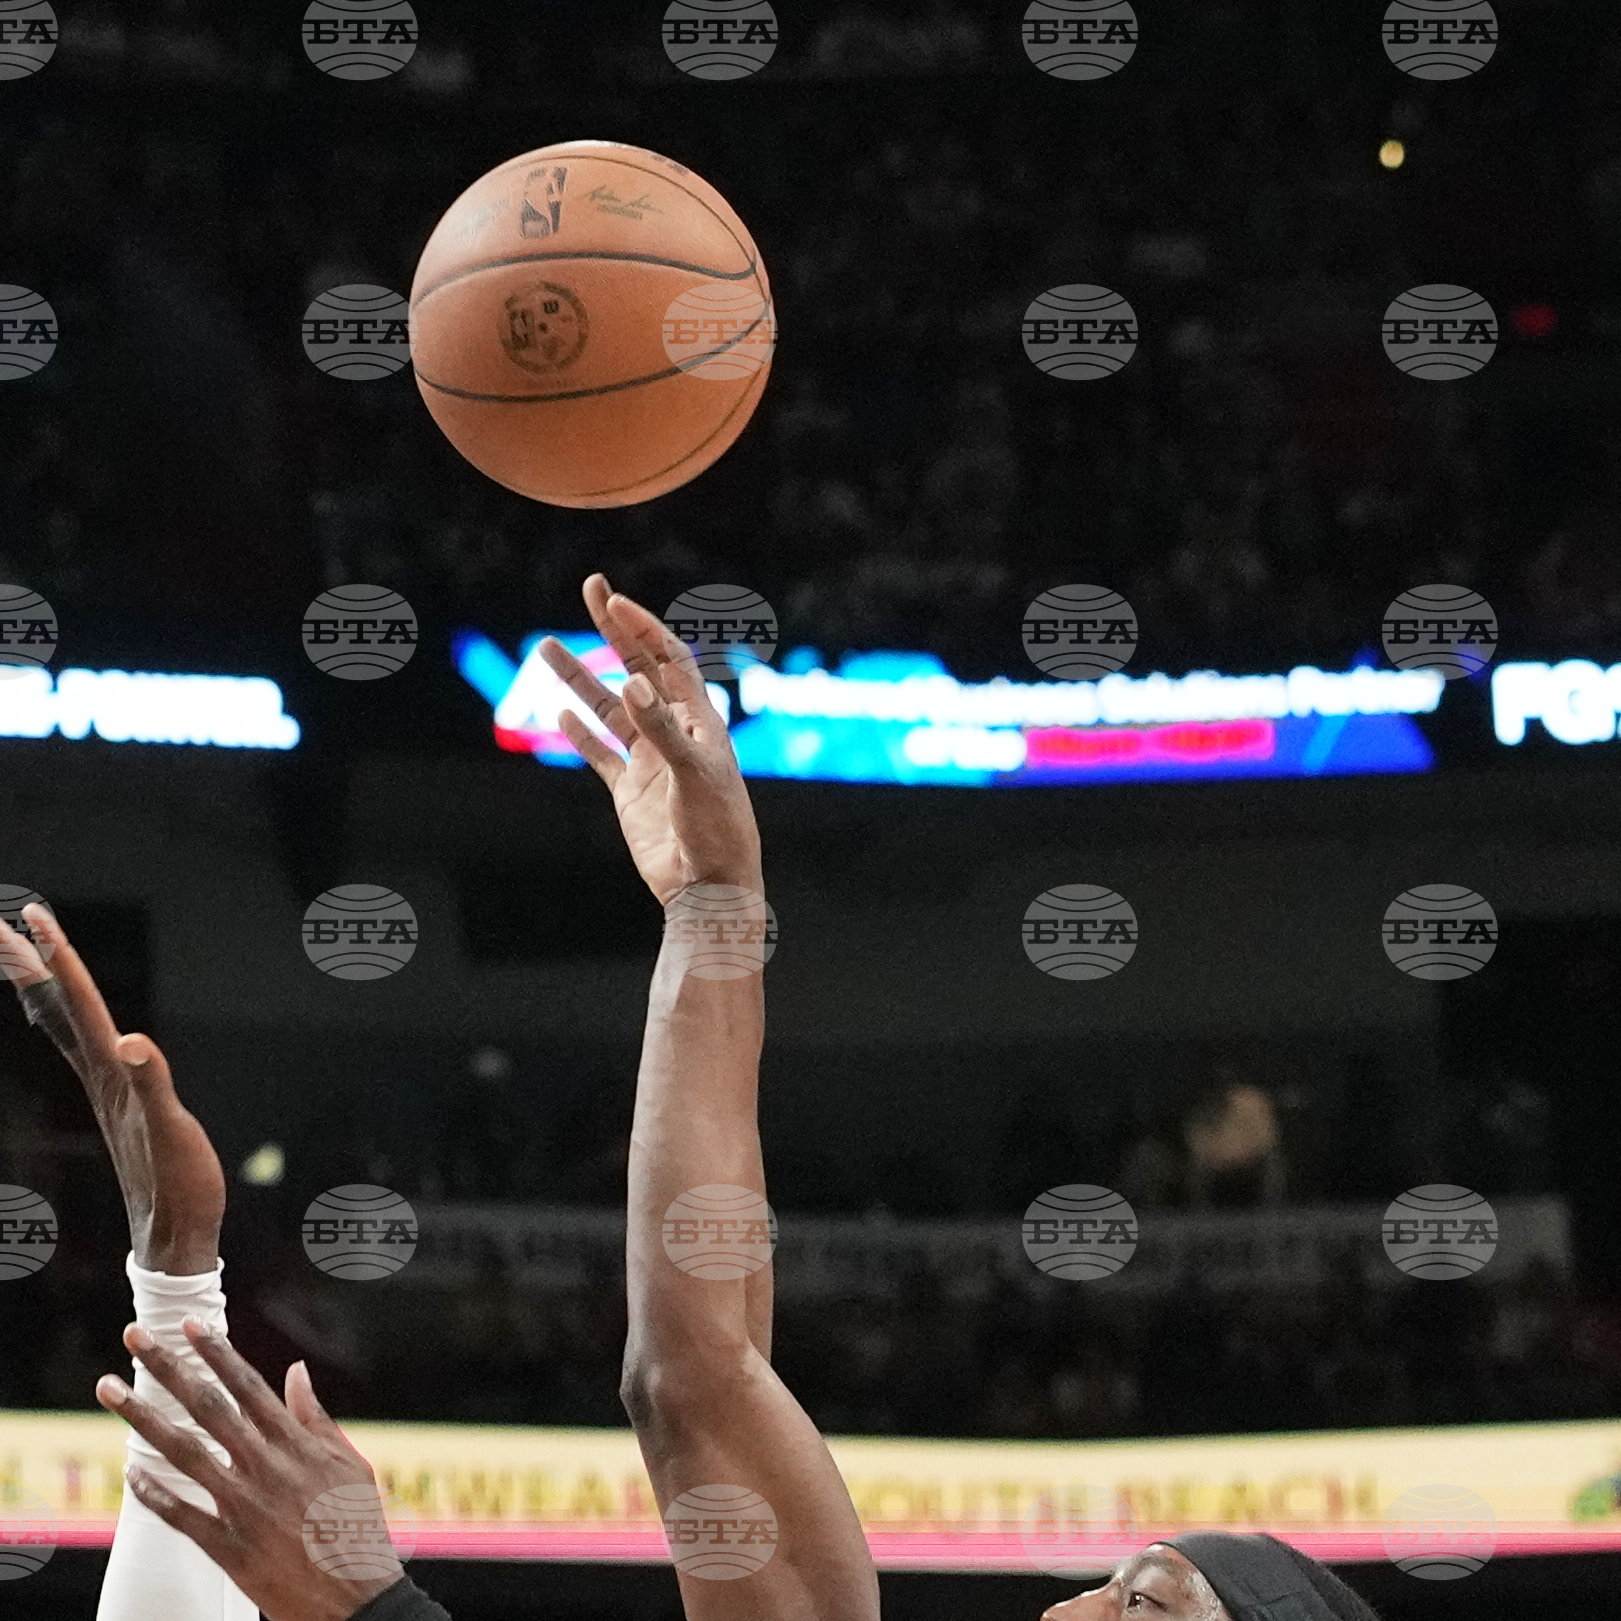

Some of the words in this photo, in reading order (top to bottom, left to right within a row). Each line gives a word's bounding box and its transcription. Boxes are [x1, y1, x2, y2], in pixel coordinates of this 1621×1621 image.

[378, 1466, 662, 1522] MWEAR
[856, 1475, 1087, 1530] OUTH
[1114, 1467, 1378, 1528] BEACH
